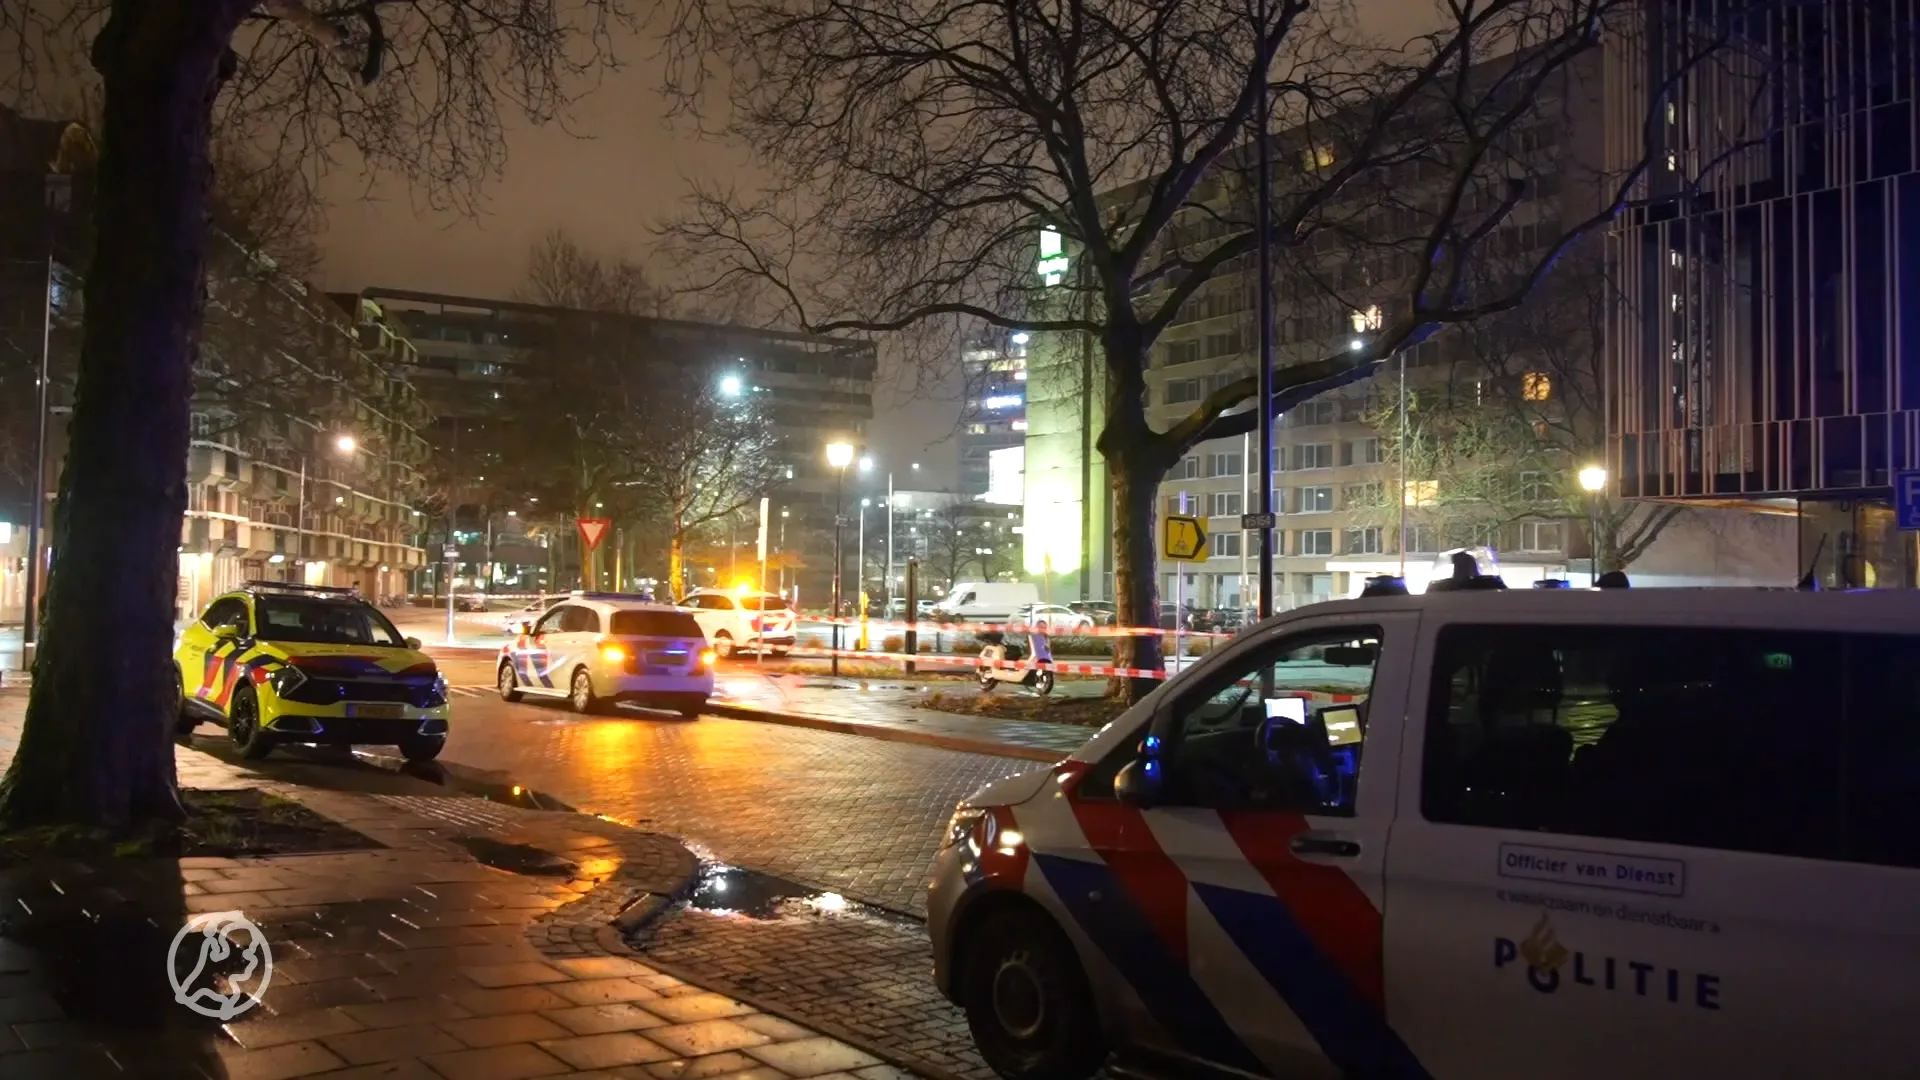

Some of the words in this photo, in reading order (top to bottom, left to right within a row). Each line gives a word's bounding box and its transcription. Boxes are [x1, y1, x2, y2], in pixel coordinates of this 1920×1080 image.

[1506, 852, 1568, 873] Officier
[1576, 863, 1607, 878] van
[1616, 864, 1676, 886] Dienst
[1592, 904, 1614, 918] en
[1616, 903, 1707, 932] dienstbaar
[1494, 937, 1721, 1010] POLITIE
